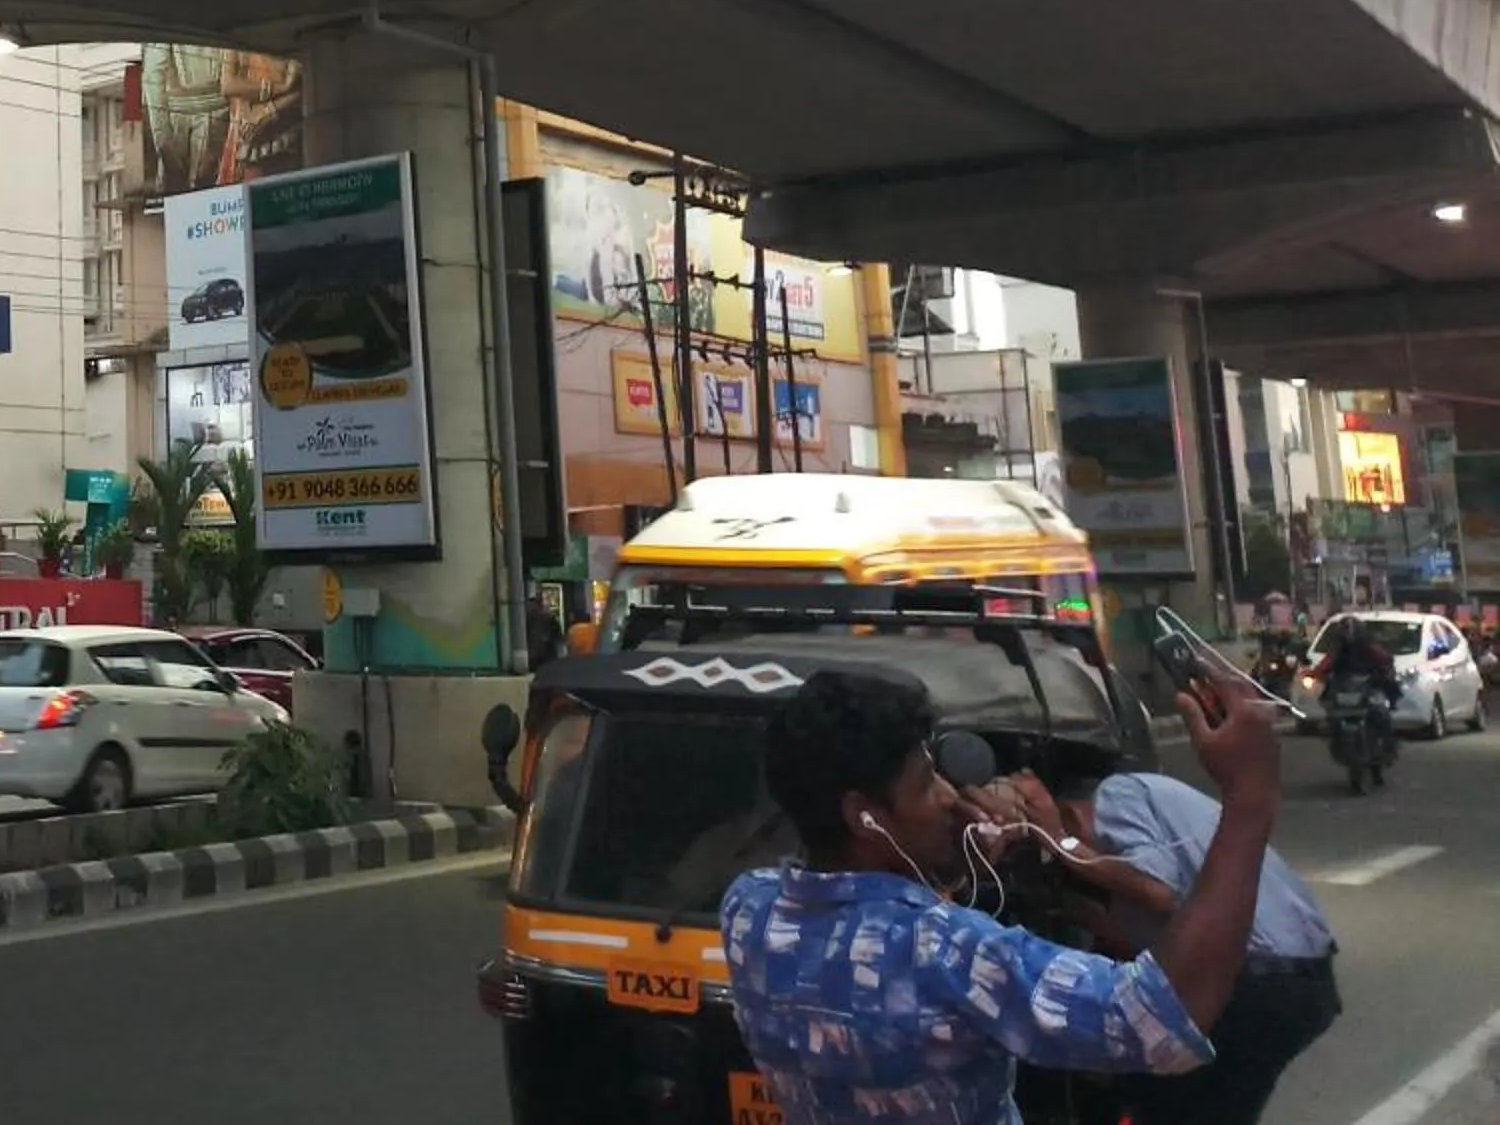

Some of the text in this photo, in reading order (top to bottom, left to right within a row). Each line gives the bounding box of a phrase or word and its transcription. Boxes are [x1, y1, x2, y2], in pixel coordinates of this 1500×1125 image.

[268, 474, 418, 500] +91 9048 366 666
[316, 509, 365, 524] Kent
[616, 970, 691, 1000] TAXI
